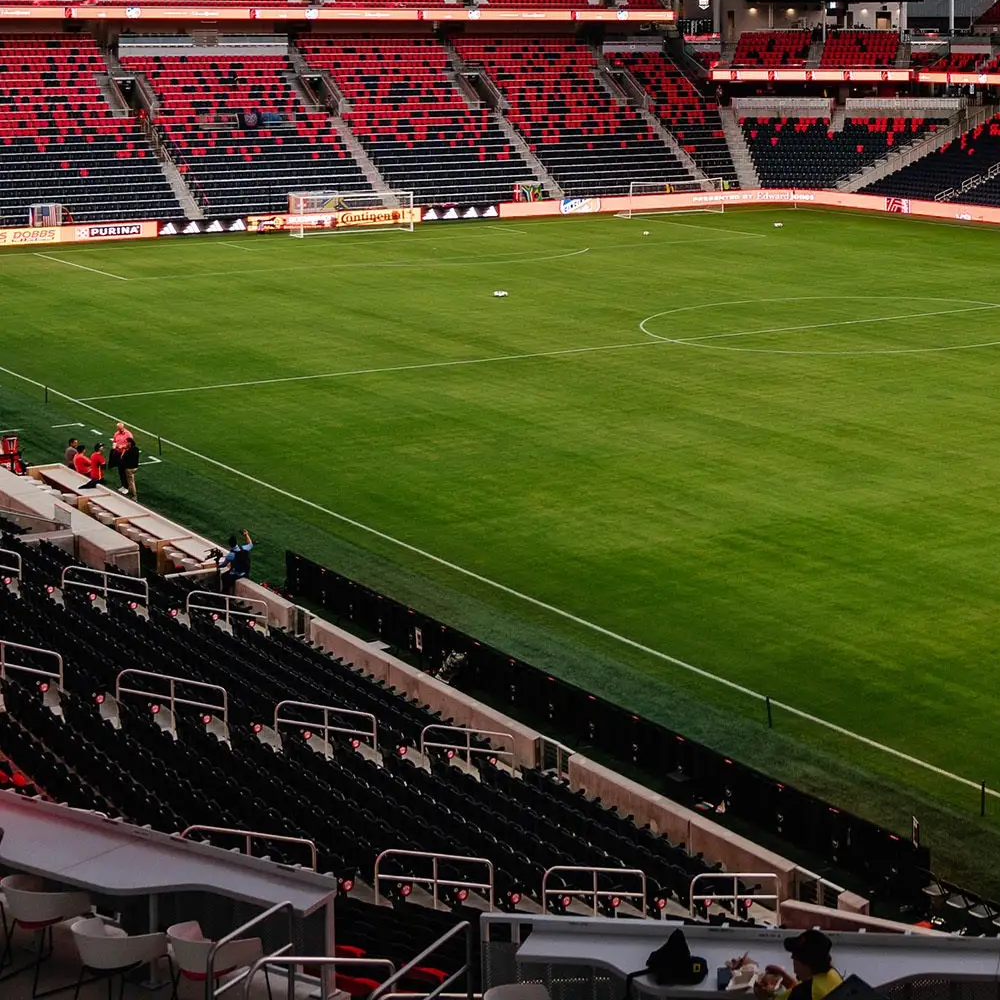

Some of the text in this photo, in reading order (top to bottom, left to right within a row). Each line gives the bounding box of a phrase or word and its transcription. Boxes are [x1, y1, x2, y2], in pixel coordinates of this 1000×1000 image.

[756, 191, 789, 201] Edward
[789, 192, 815, 202] Jones
[13, 229, 57, 240] DOBBS
[90, 226, 139, 237] PURINA
